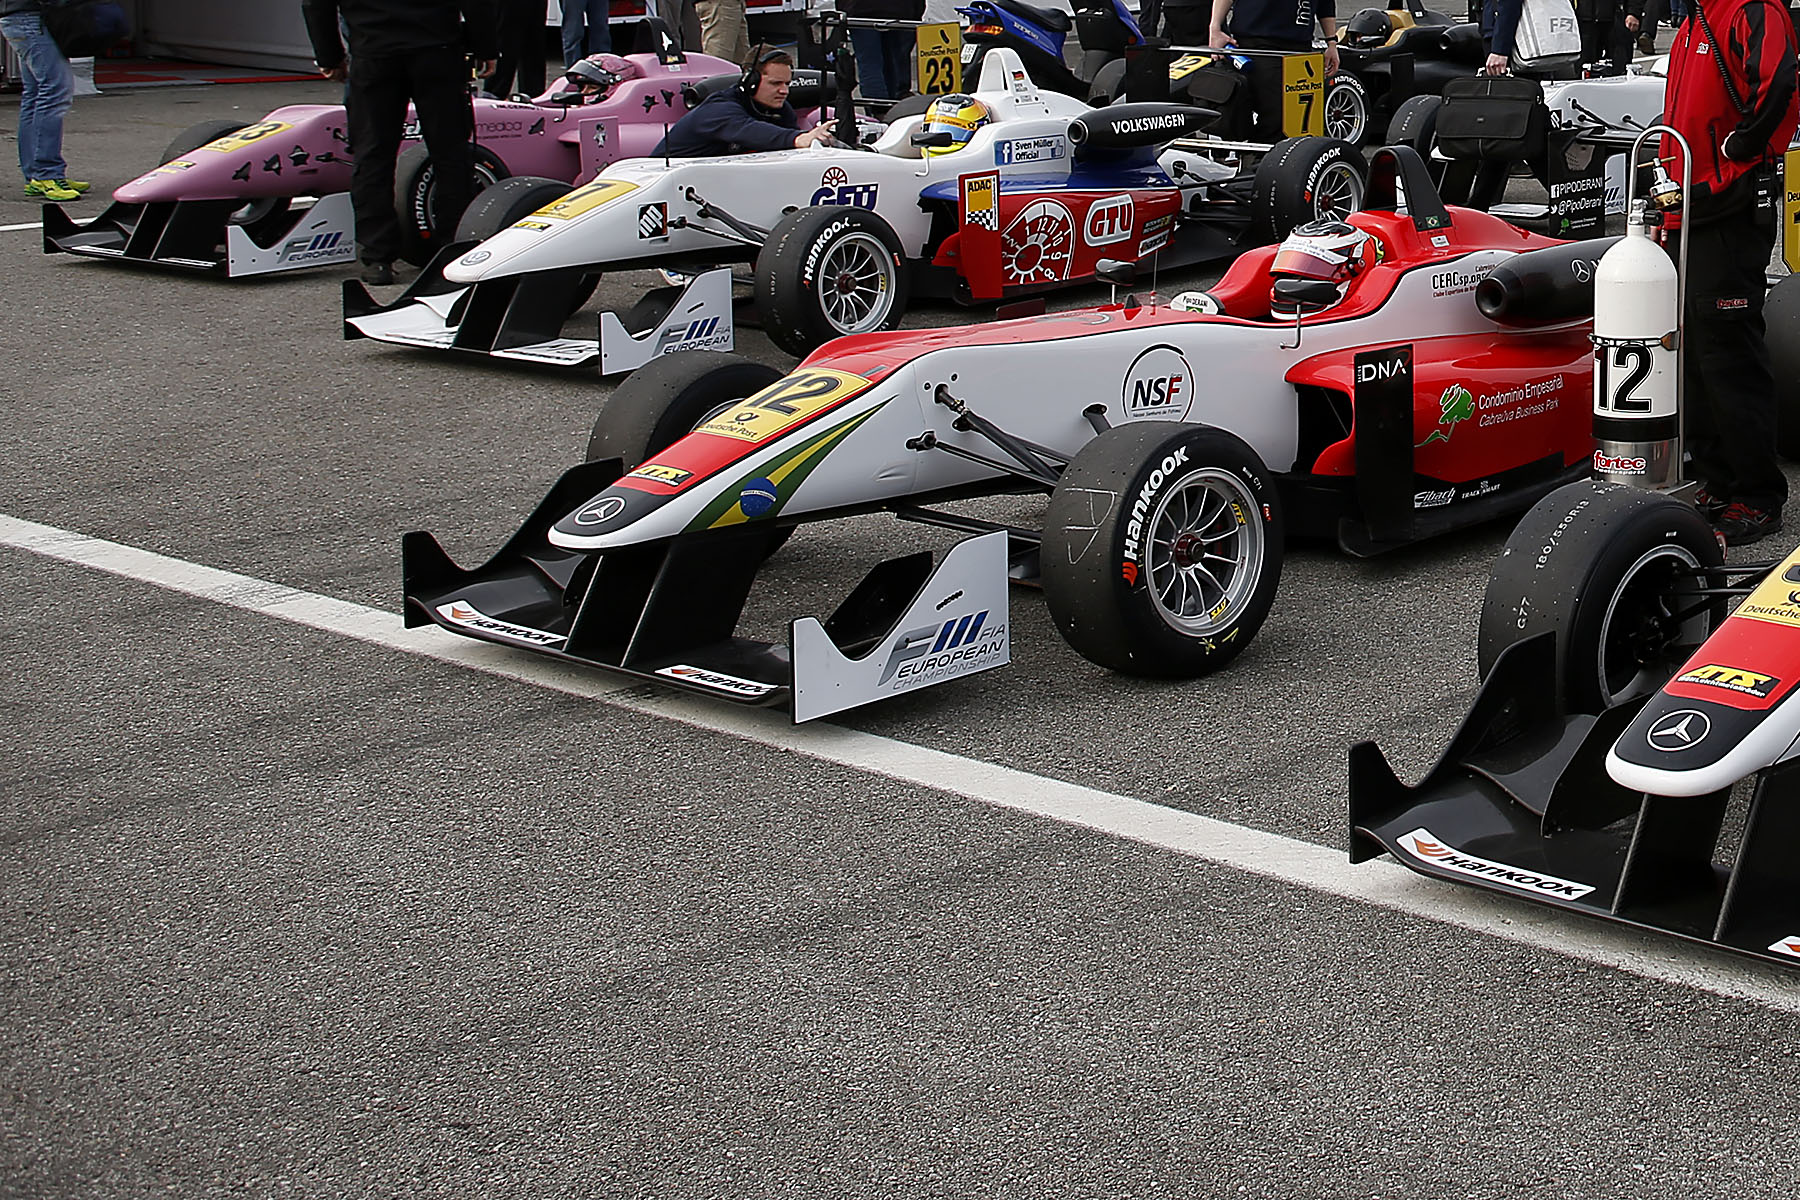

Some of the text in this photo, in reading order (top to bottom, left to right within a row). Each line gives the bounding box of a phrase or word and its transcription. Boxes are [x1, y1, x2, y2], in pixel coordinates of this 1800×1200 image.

[919, 49, 943, 58] Deutsche
[945, 47, 959, 56] Post
[925, 56, 955, 95] 23
[1285, 81, 1322, 93] Deutsche Post
[1111, 113, 1185, 135] VOLKSWAGEN
[1297, 93, 1314, 134] 7
[1015, 138, 1055, 151] Sven Müller
[1015, 150, 1040, 161] Official
[967, 179, 992, 194] ADAC
[1558, 178, 1602, 194] PIPODERANI
[1558, 195, 1602, 216] @PipoDerani
[288, 245, 352, 262] EUROPEAN
[714, 325, 732, 338] FIA
[663, 334, 731, 355] EUROPEAN
[1362, 358, 1407, 382] DNA
[1595, 343, 1654, 415] 12
[744, 374, 843, 415] 12
[1131, 376, 1183, 409] NSF
[1478, 388, 1525, 410] Condominio
[1479, 398, 1560, 428] Cabreúva Business Park
[739, 426, 758, 438] Post
[1594, 450, 1647, 472] fortec
[1414, 487, 1457, 505] Eibach
[1461, 491, 1480, 499] TRACK
[1535, 499, 1590, 571] 180/550R13
[980, 624, 1005, 642] FIA
[896, 638, 1005, 679] EUROPEAN
[890, 652, 1001, 691] CHAMPIONSHIP
[1693, 664, 1772, 688] ATS
